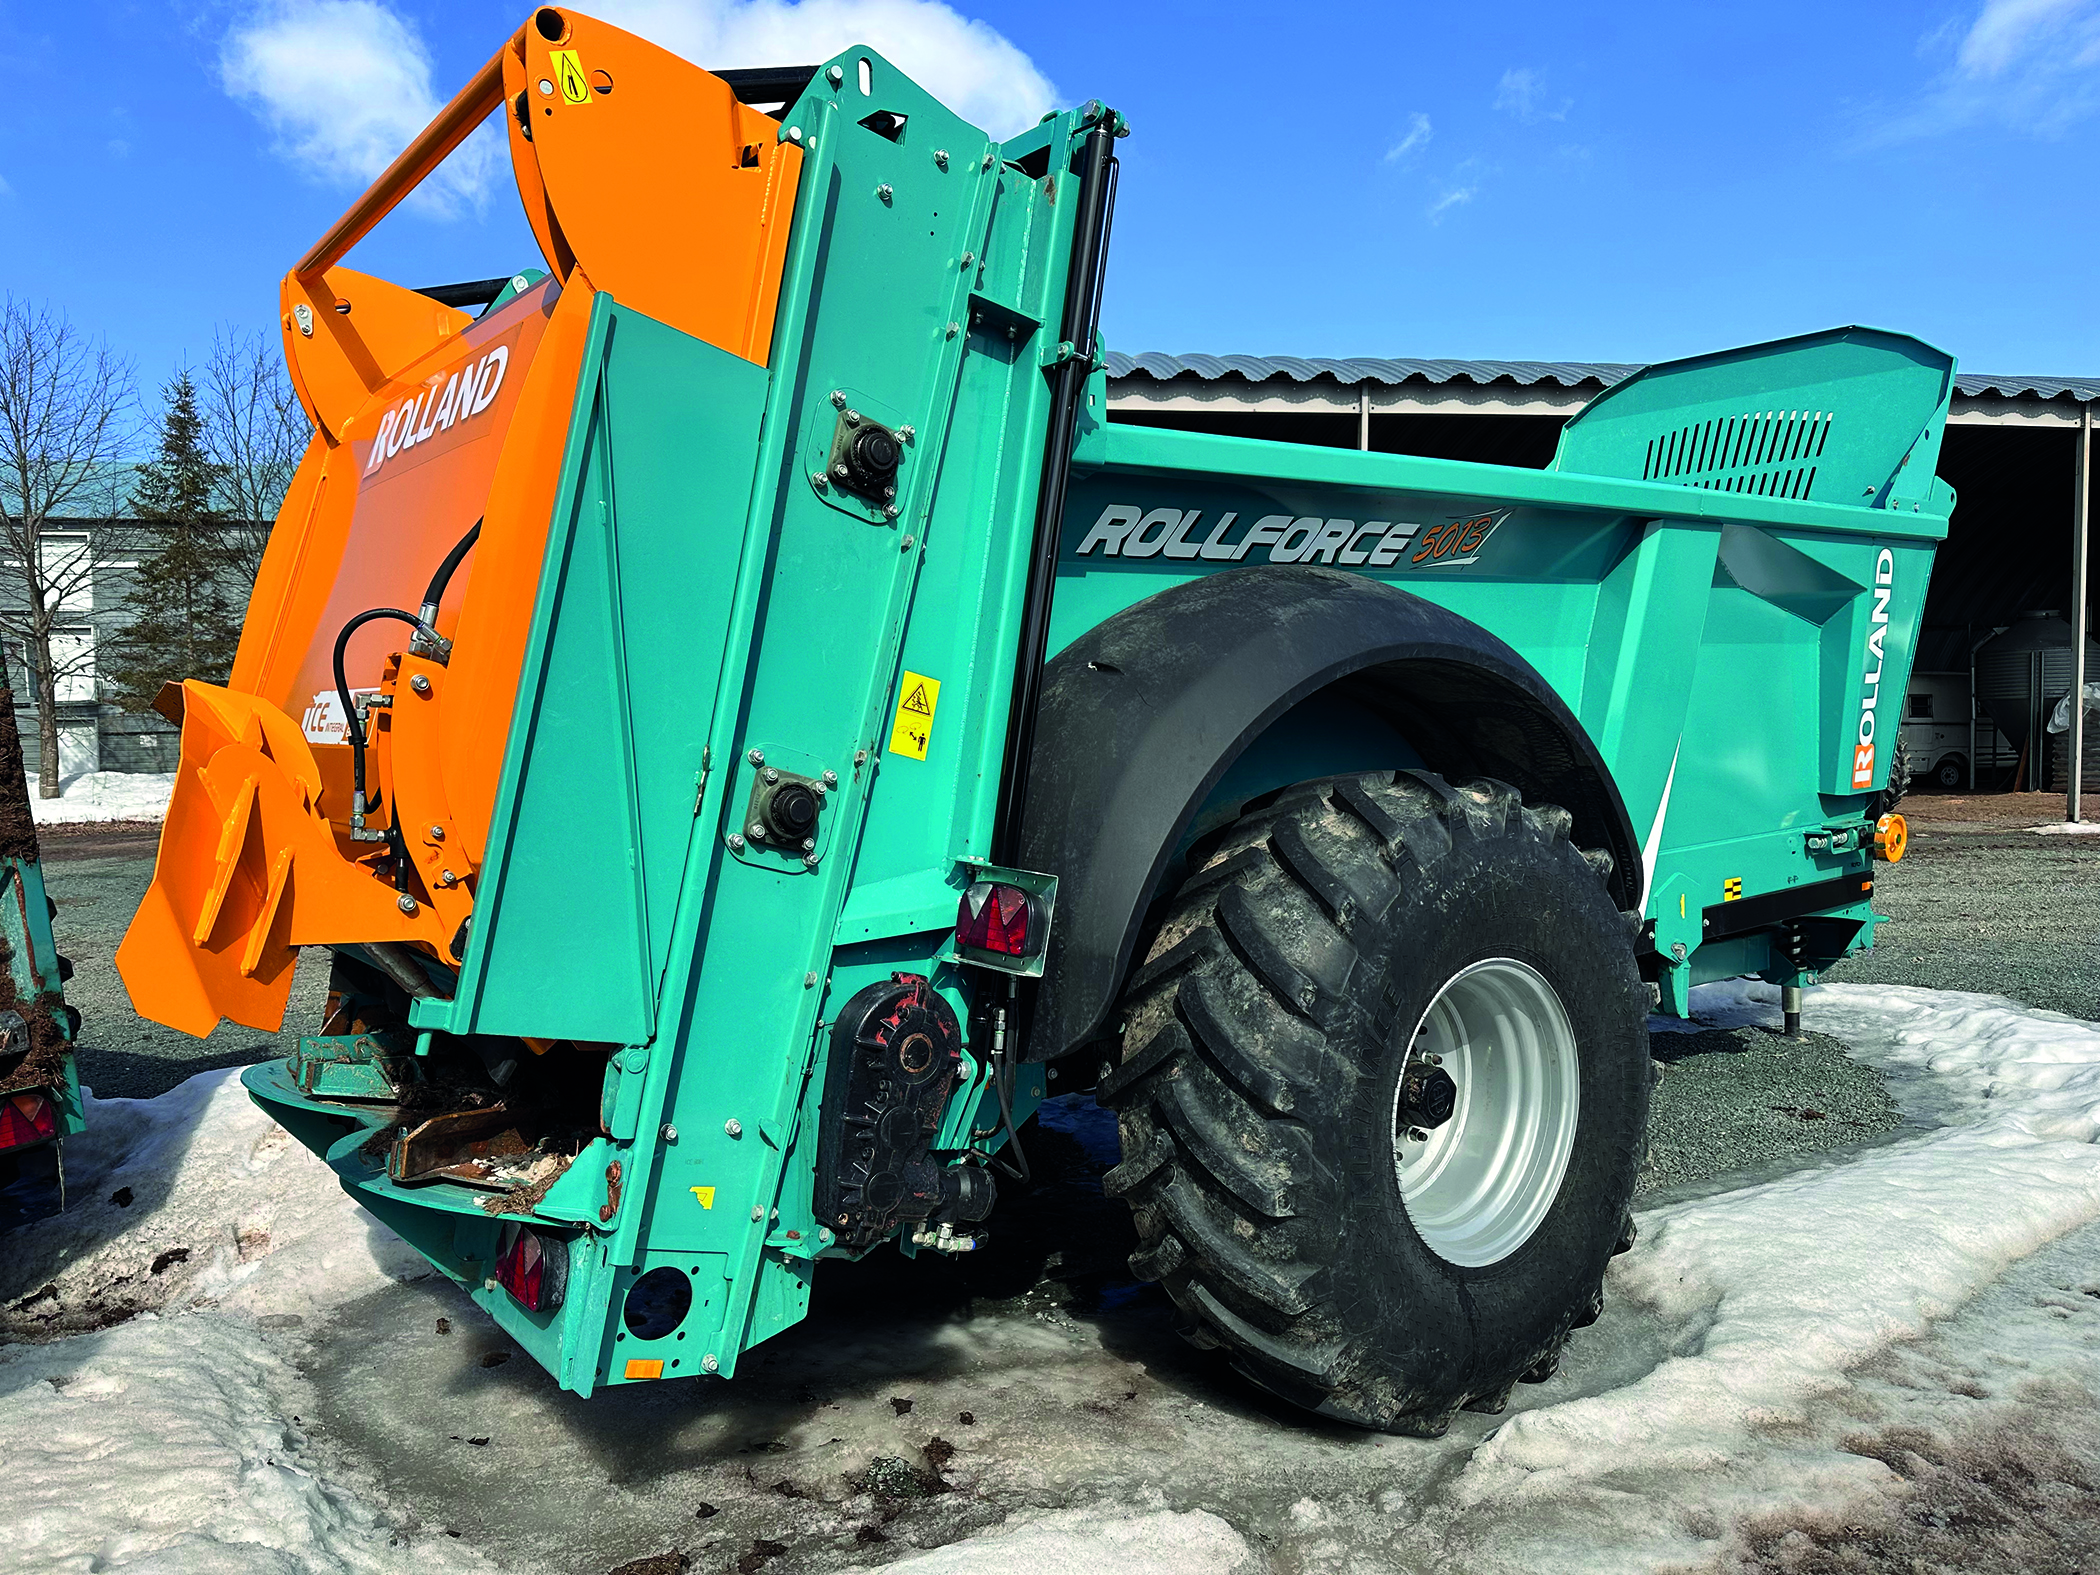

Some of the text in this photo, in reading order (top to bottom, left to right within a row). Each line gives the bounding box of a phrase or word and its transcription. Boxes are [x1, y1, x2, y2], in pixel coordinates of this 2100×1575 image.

[364, 345, 509, 475] ROLLAND
[1075, 503, 1492, 566] ROLLFORCE 5013
[1853, 548, 1894, 787] ROLLAND
[1352, 982, 1400, 1207] ALLIANCE
